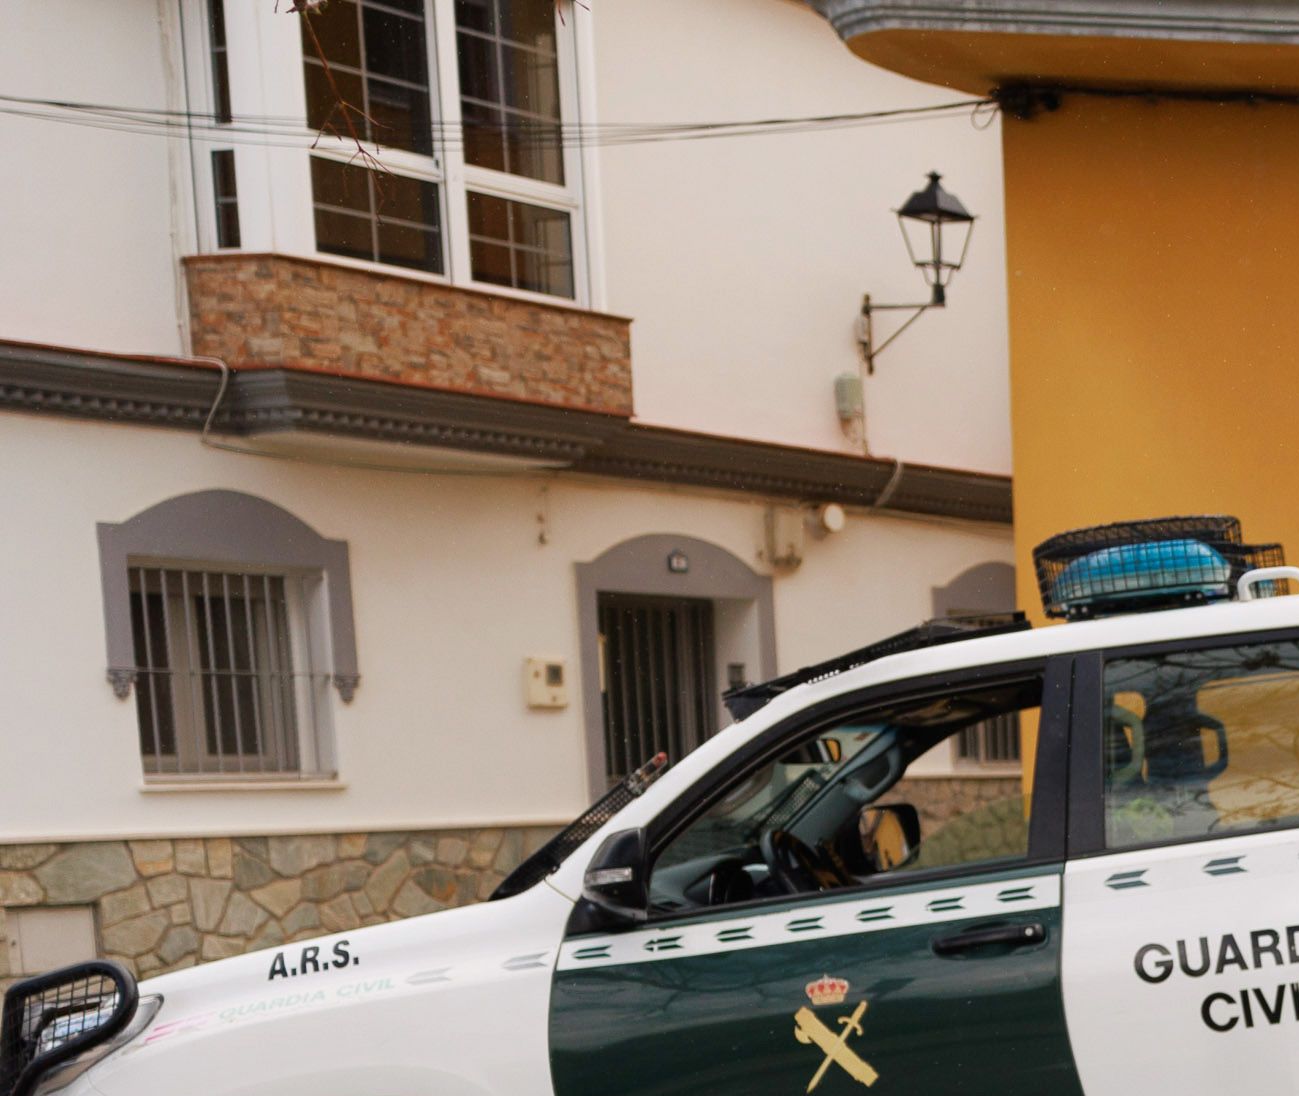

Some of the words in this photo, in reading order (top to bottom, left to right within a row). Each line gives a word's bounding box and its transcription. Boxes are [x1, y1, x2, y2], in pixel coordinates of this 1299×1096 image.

[268, 940, 360, 981] A.R.S.
[219, 989, 326, 1021] GUARDIA
[336, 977, 395, 998] CIVIL
